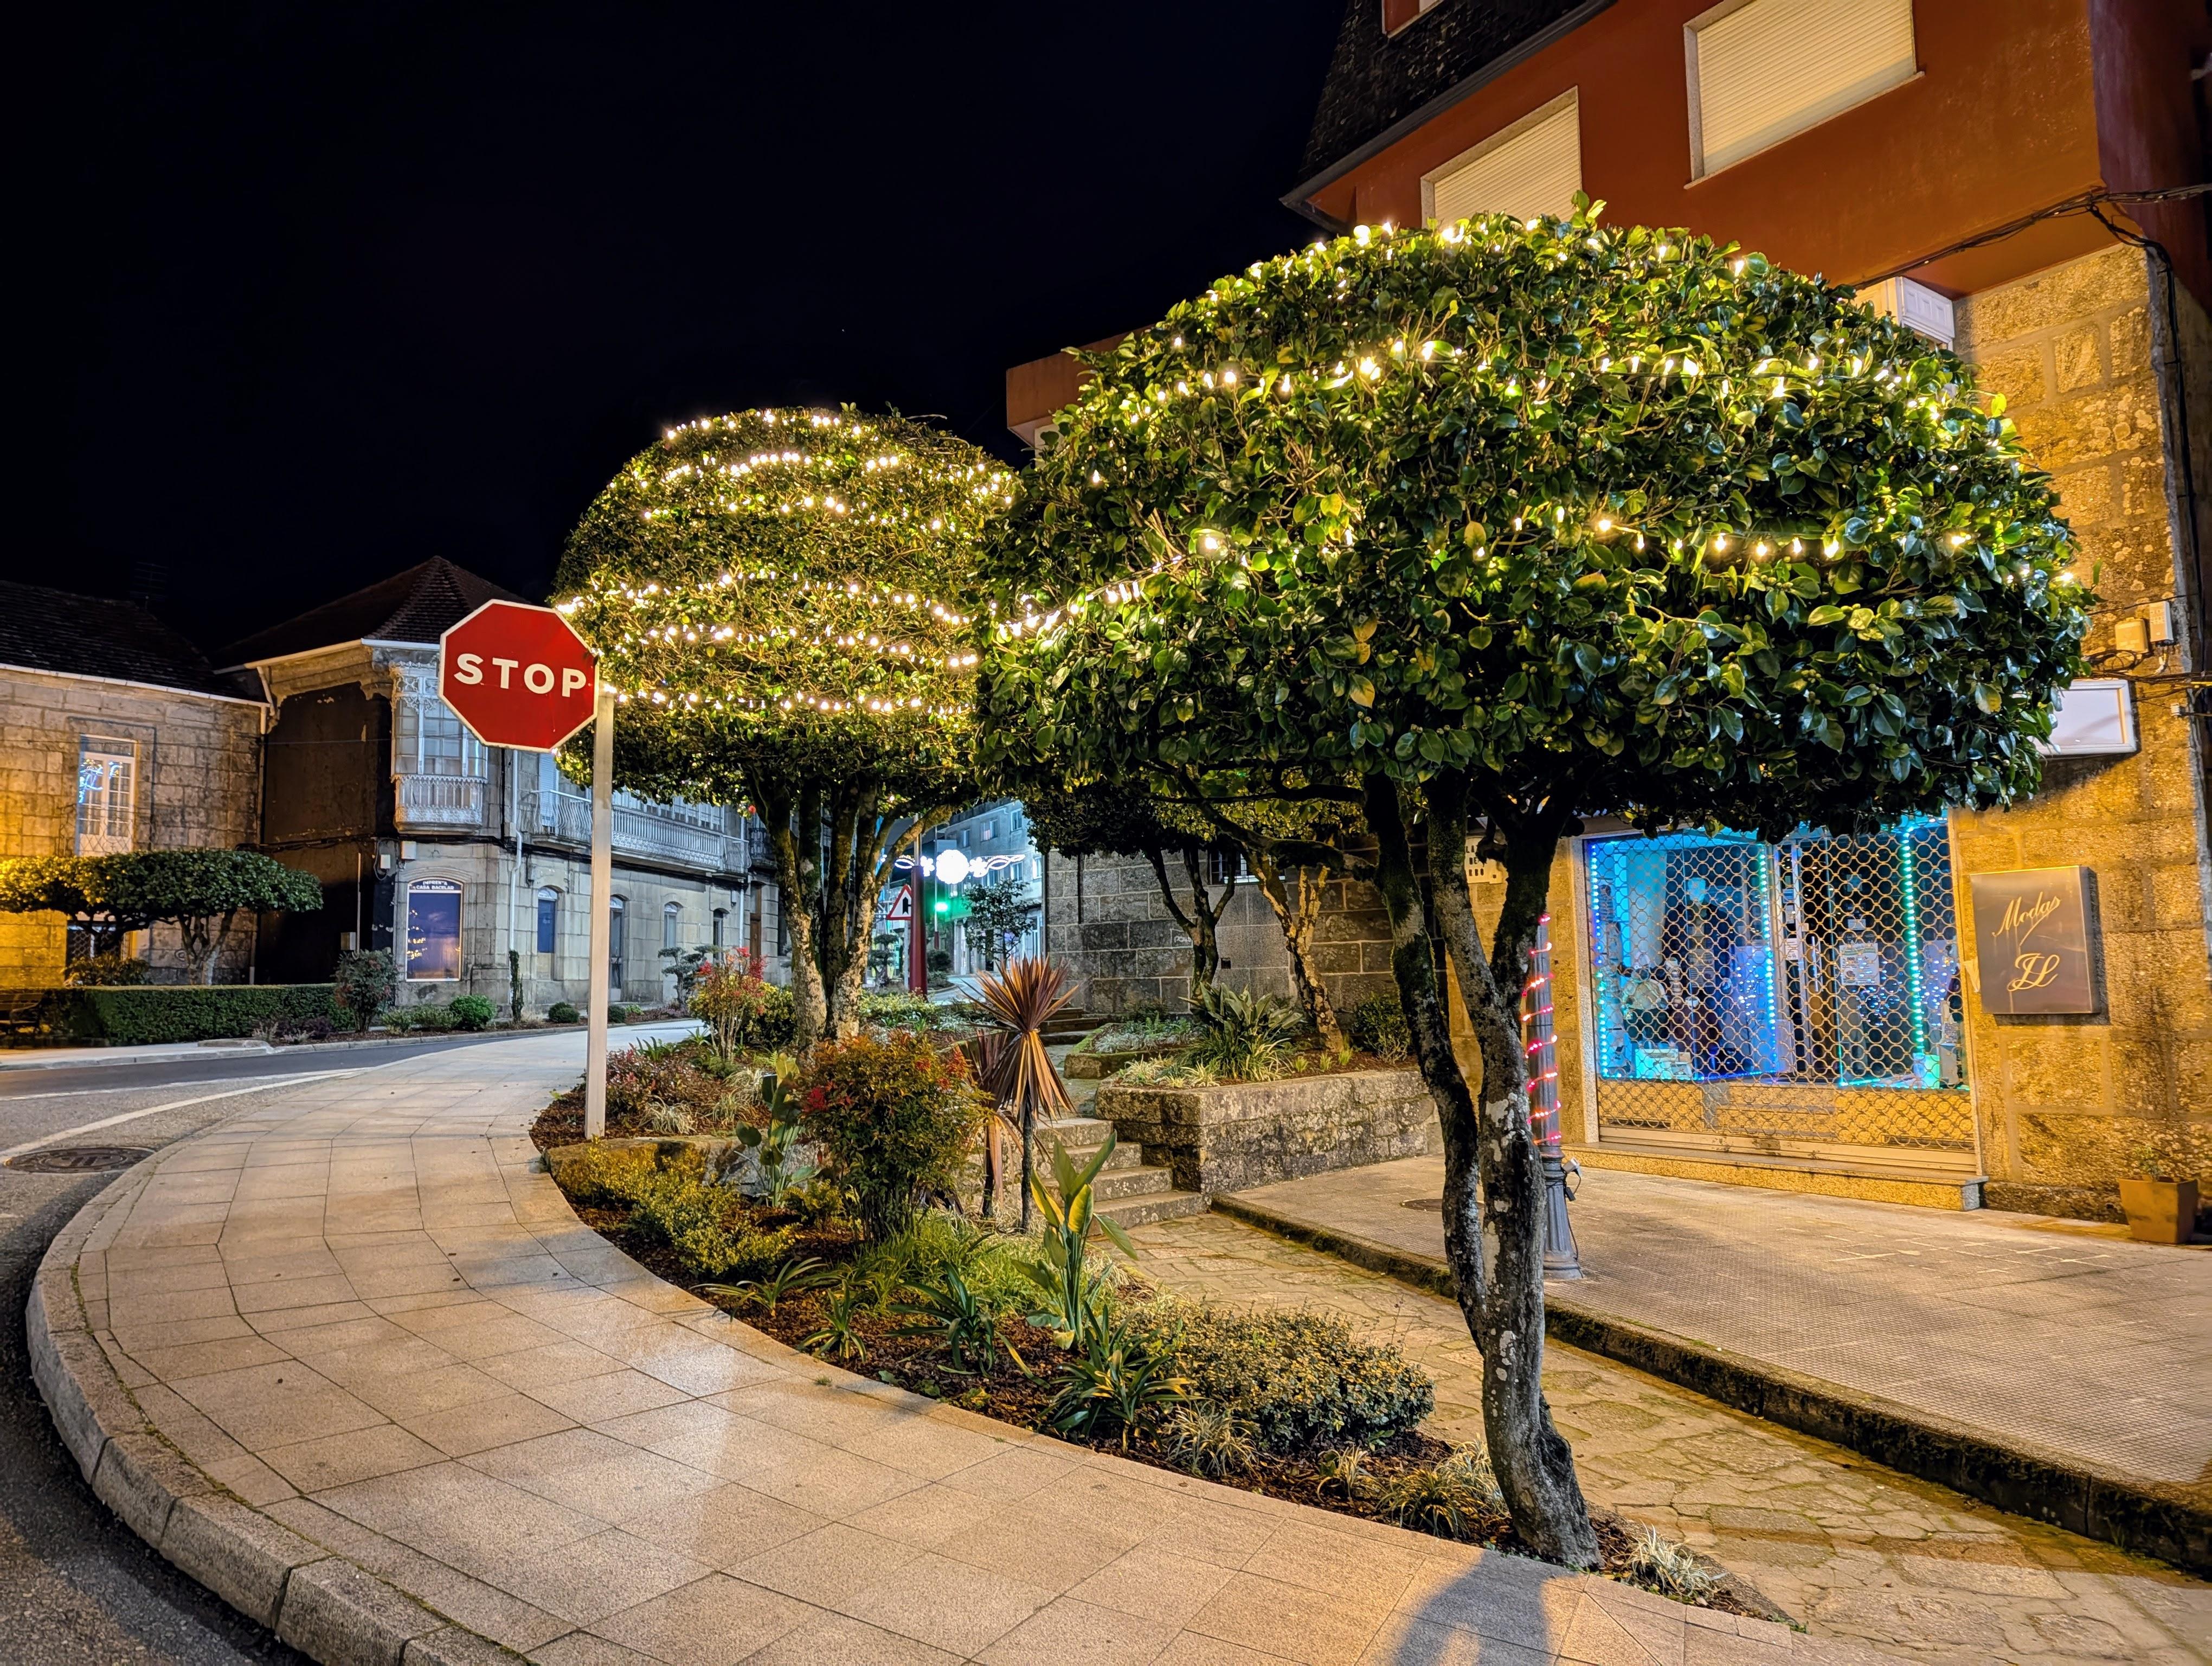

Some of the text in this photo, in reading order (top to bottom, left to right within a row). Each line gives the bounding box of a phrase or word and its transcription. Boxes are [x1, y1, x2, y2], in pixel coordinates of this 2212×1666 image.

[453, 653, 587, 697] STOP
[1469, 868, 1484, 876] RBO
[1991, 891, 2061, 946] Modas
